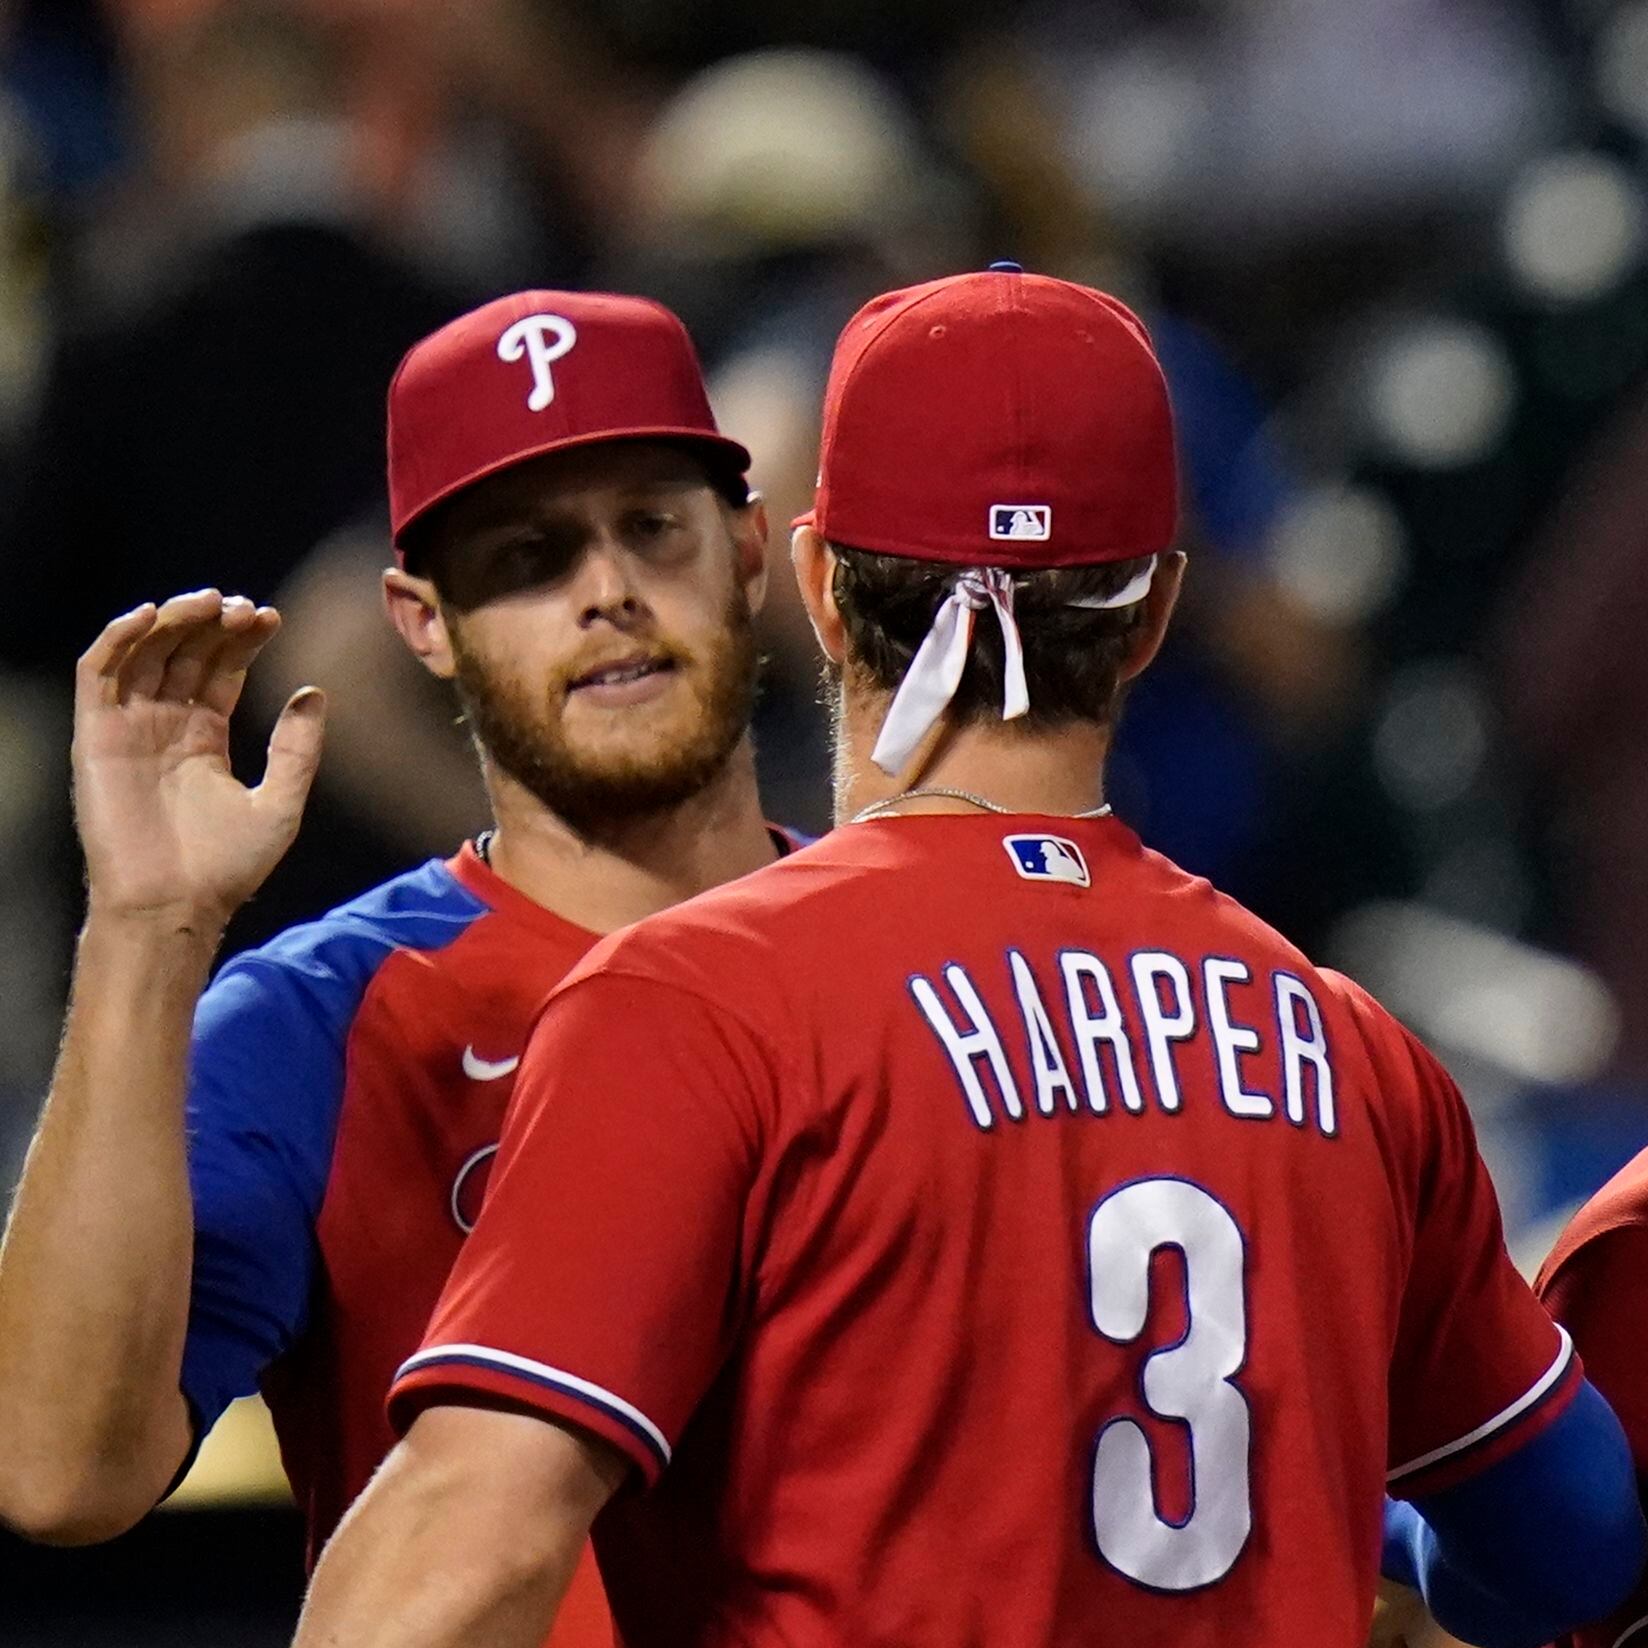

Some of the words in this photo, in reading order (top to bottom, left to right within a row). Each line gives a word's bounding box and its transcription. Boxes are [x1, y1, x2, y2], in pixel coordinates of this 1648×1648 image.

[498, 313, 576, 412] P
[905, 947, 1339, 1138] HARPER
[1087, 1175, 1252, 1594] 3
